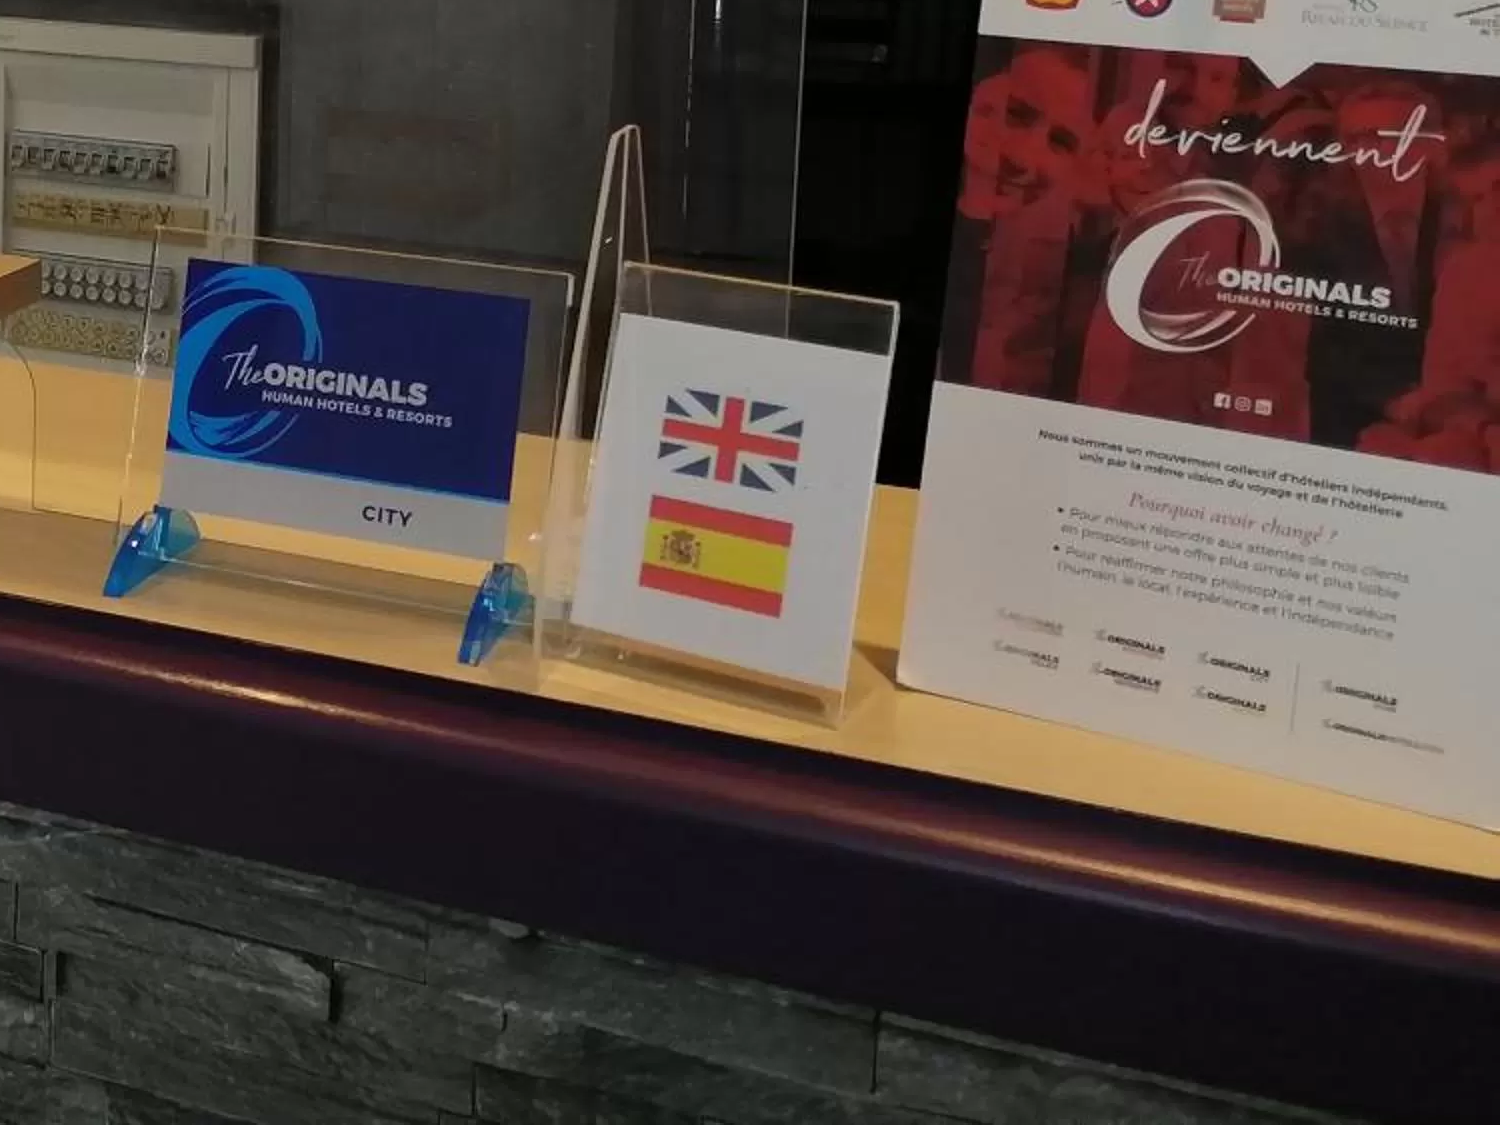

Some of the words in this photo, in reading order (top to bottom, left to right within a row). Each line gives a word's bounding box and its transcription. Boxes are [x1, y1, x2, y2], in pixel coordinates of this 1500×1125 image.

[1124, 78, 1445, 183] deviennent
[1217, 266, 1392, 310] ORIGINALS
[1216, 291, 1271, 312] HUMAN
[1273, 298, 1332, 319] HOTELS
[1347, 308, 1420, 330] RESORTS
[222, 344, 267, 391] The
[262, 362, 429, 407] ORIGINALS
[261, 389, 313, 408] HUMAN
[316, 397, 372, 419] HOTELS
[373, 406, 384, 419] &
[386, 408, 453, 429] RESORTS
[1038, 429, 1070, 444] Nous
[1072, 436, 1123, 452] sommes
[1126, 445, 1143, 455] un
[1145, 449, 1222, 471] mouvement
[1223, 462, 1277, 480] collectif
[1227, 477, 1244, 490] du
[1247, 483, 1293, 500] voyage
[1296, 491, 1308, 502] et
[1311, 494, 1329, 506] de
[361, 505, 414, 528] CITY
[1069, 506, 1102, 523] Pour
[1128, 491, 1207, 521] Pourquoi
[1209, 510, 1257, 530] avoir
[1261, 518, 1325, 548] changé
[1327, 529, 1339, 544] ?
